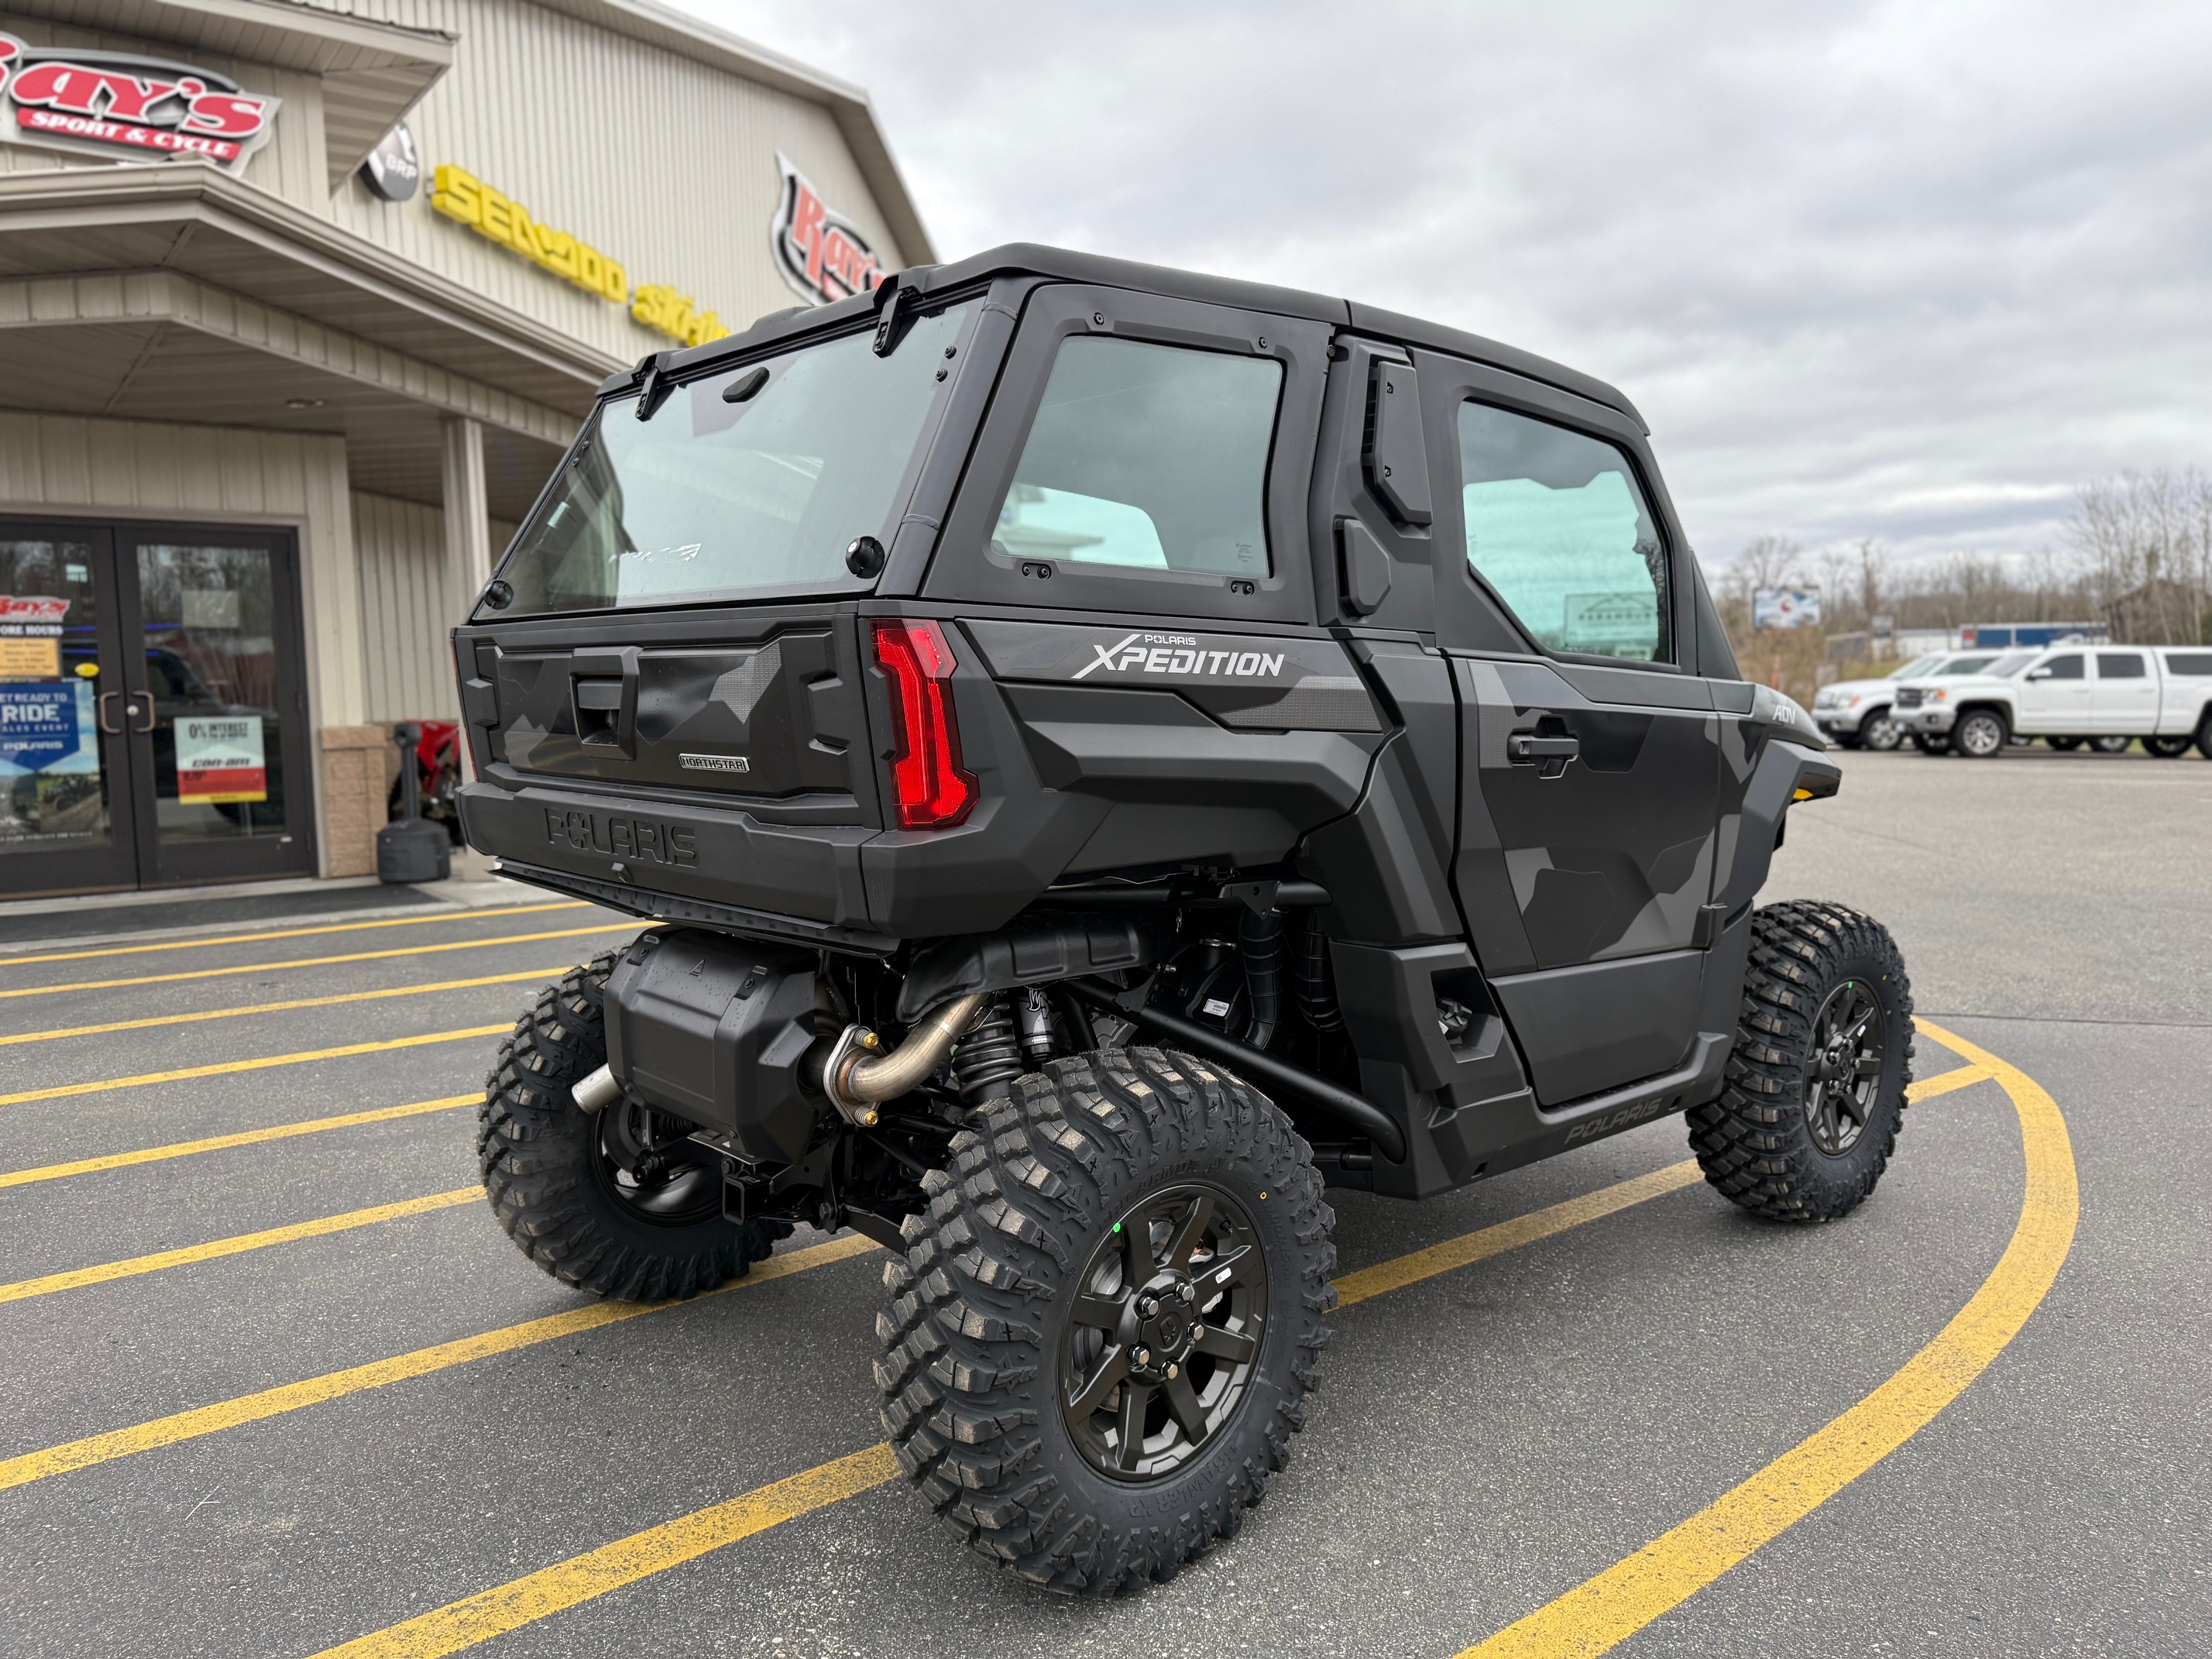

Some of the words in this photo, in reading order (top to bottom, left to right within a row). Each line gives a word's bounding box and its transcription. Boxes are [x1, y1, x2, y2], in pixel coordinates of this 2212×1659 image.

[29, 111, 125, 138] SPORT
[124, 127, 148, 144] &
[153, 132, 233, 156] CYCLE
[386, 153, 417, 180] BRP
[26, 625, 64, 635] HOURS
[1144, 634, 1197, 645] POLARIS
[1070, 634, 1285, 679] XPEDITION
[15, 693, 51, 702] READY
[53, 692, 68, 702] TO
[1772, 704, 1796, 725] ADV
[34, 723, 70, 733] EVENT
[189, 723, 208, 740] 0%
[3, 741, 64, 750] POLARIS
[682, 757, 744, 771] NORTHSTAR
[544, 808, 699, 869] POLARIS
[1563, 1096, 1663, 1145] POLARIS
